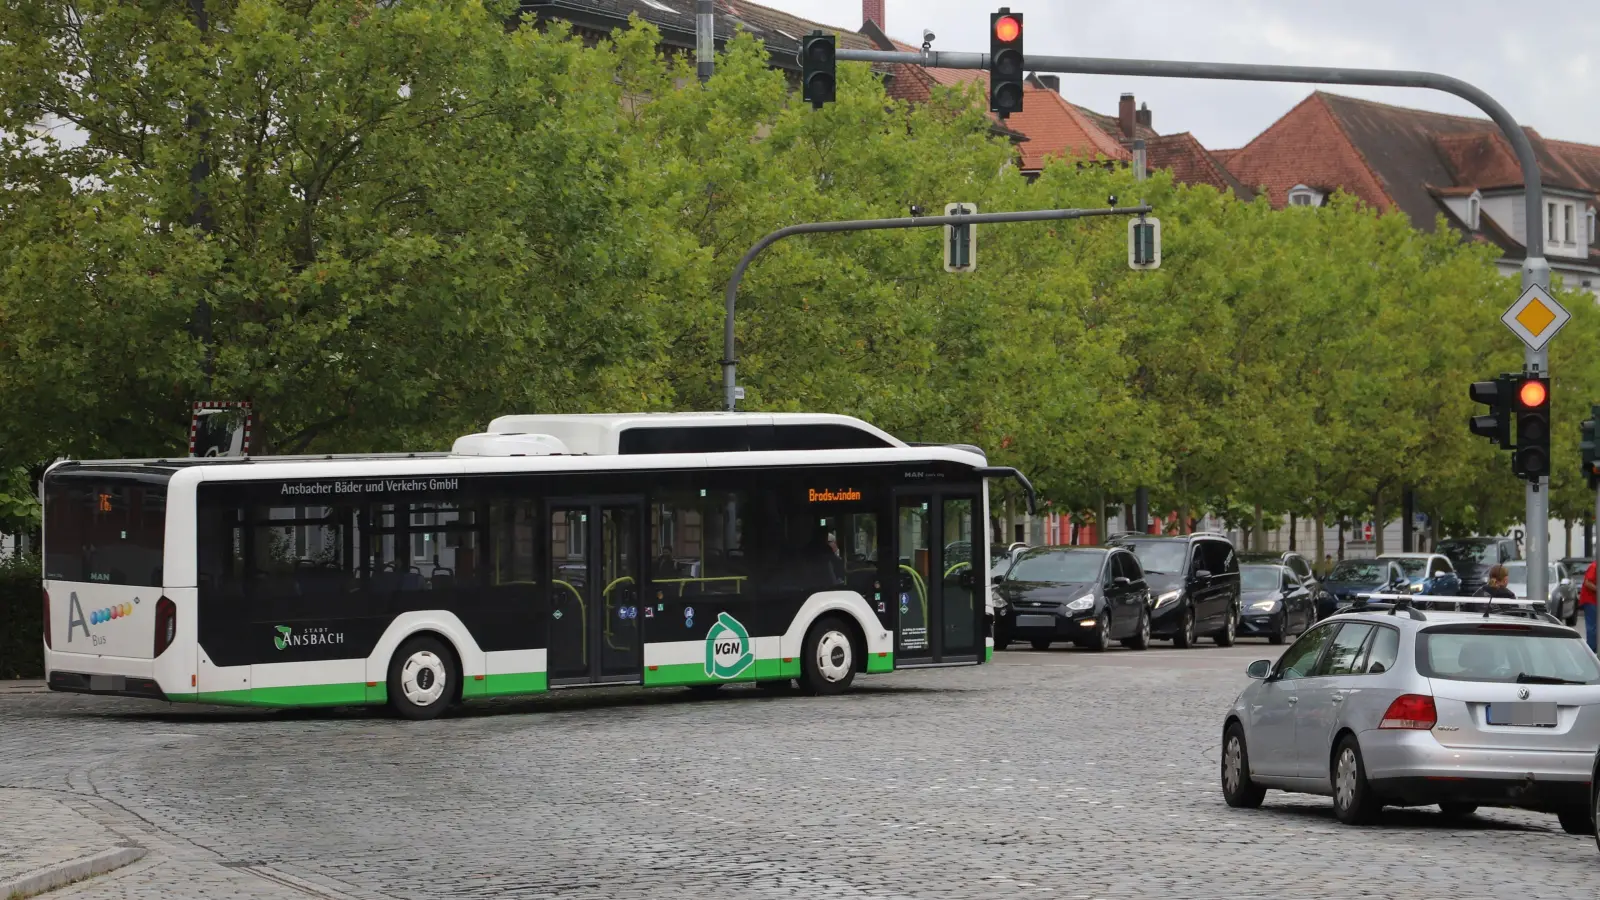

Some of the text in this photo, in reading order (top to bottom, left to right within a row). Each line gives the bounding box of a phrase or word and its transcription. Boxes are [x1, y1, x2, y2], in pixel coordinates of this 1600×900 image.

[281, 478, 458, 495] Ansbacher Bäder und Verkehrs GmbH
[808, 488, 861, 502] Brodswinden
[90, 572, 110, 581] MAN
[67, 591, 91, 643] A
[282, 632, 344, 646] ANSBACH
[715, 642, 740, 655] VGN
